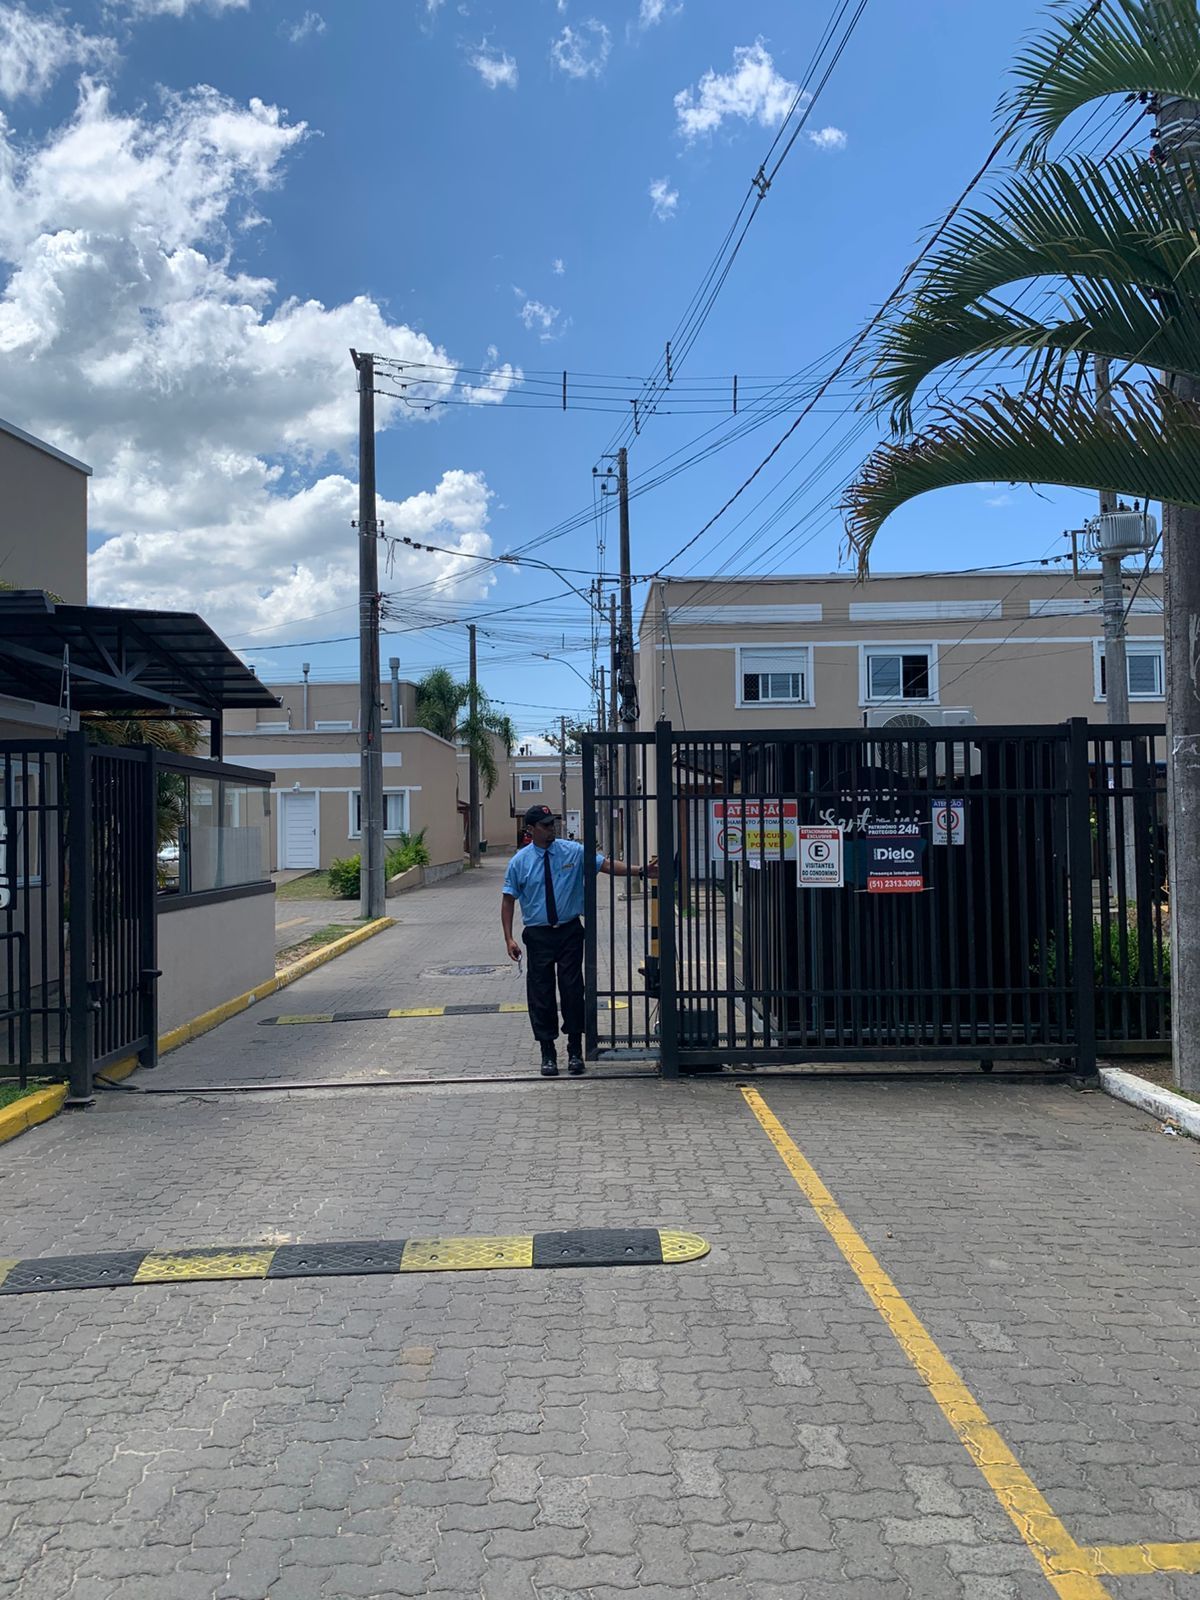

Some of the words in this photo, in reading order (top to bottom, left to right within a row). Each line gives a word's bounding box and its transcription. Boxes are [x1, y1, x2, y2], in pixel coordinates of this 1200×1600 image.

[898, 824, 919, 835] 24h
[814, 845, 824, 857] E
[876, 847, 915, 860] Dielo
[869, 880, 884, 889] (51)
